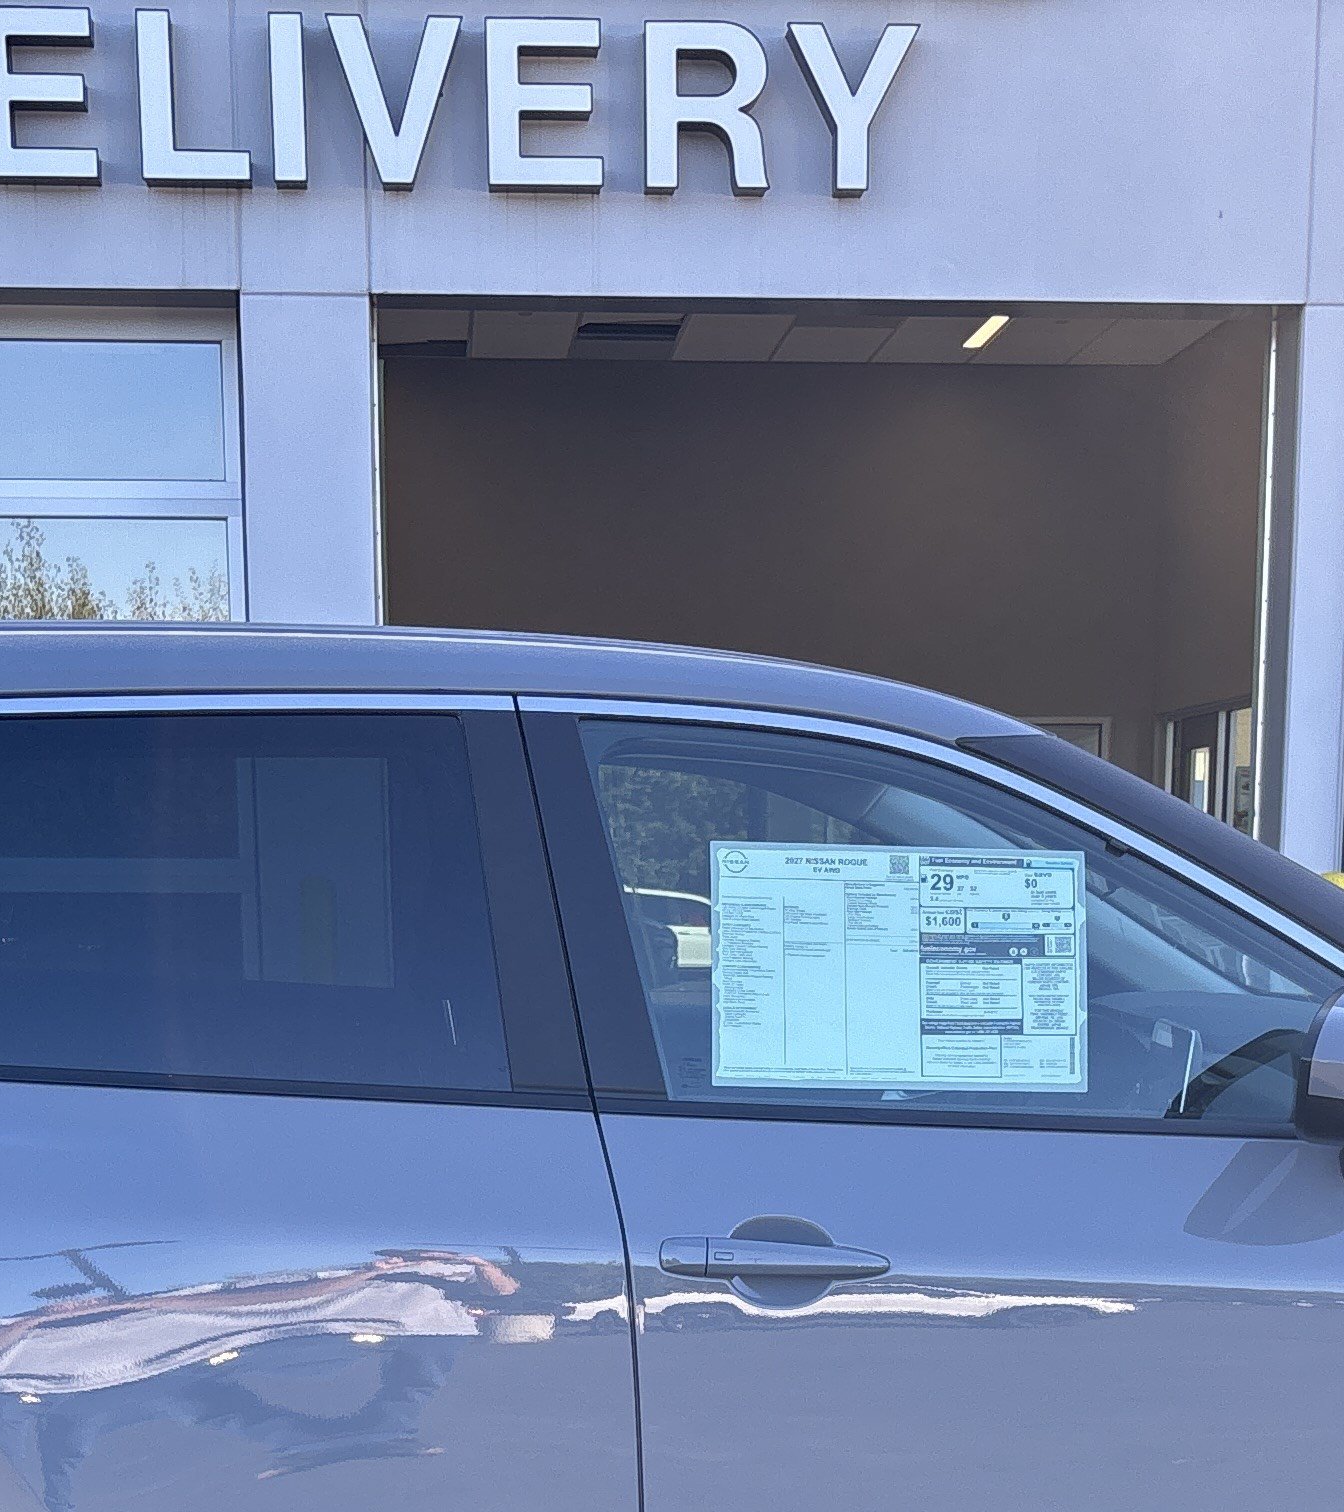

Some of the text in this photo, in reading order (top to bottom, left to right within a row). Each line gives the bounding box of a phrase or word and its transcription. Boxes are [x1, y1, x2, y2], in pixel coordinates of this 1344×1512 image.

[805, 857, 835, 866] NISSAN
[929, 873, 954, 891] 29
[1024, 878, 1038, 889] $0
[925, 916, 961, 928] $1,600
